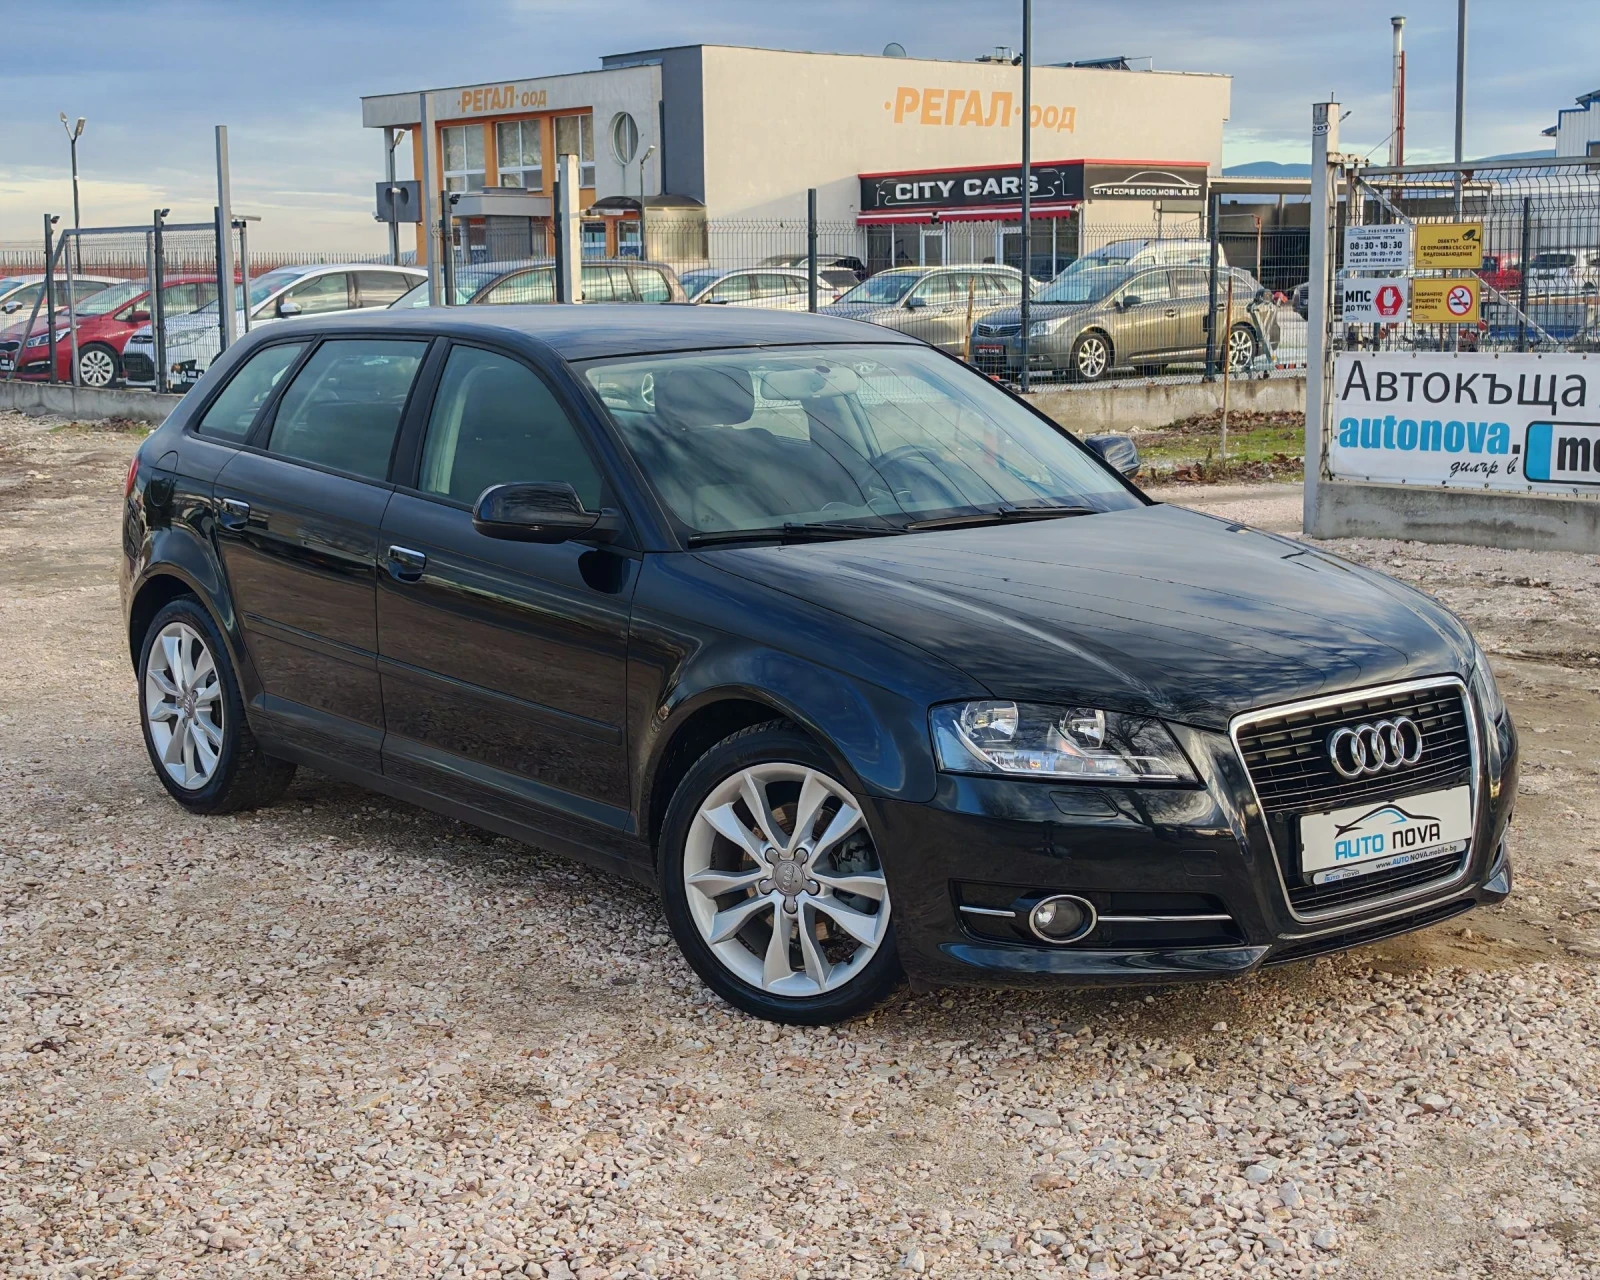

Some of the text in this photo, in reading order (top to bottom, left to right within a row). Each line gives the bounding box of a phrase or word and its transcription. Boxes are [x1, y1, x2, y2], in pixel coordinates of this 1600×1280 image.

[462, 86, 514, 113] РЕГАЛ
[894, 86, 1013, 127] РЕГАЛ
[896, 176, 1039, 200] CITY CARS
[1345, 290, 1371, 302] МПС
[1342, 360, 1587, 416] Автокъща
[1339, 415, 1521, 454] autonova.
[1450, 457, 1518, 478] дилър в
[1335, 823, 1440, 860] AUTO NOVA
